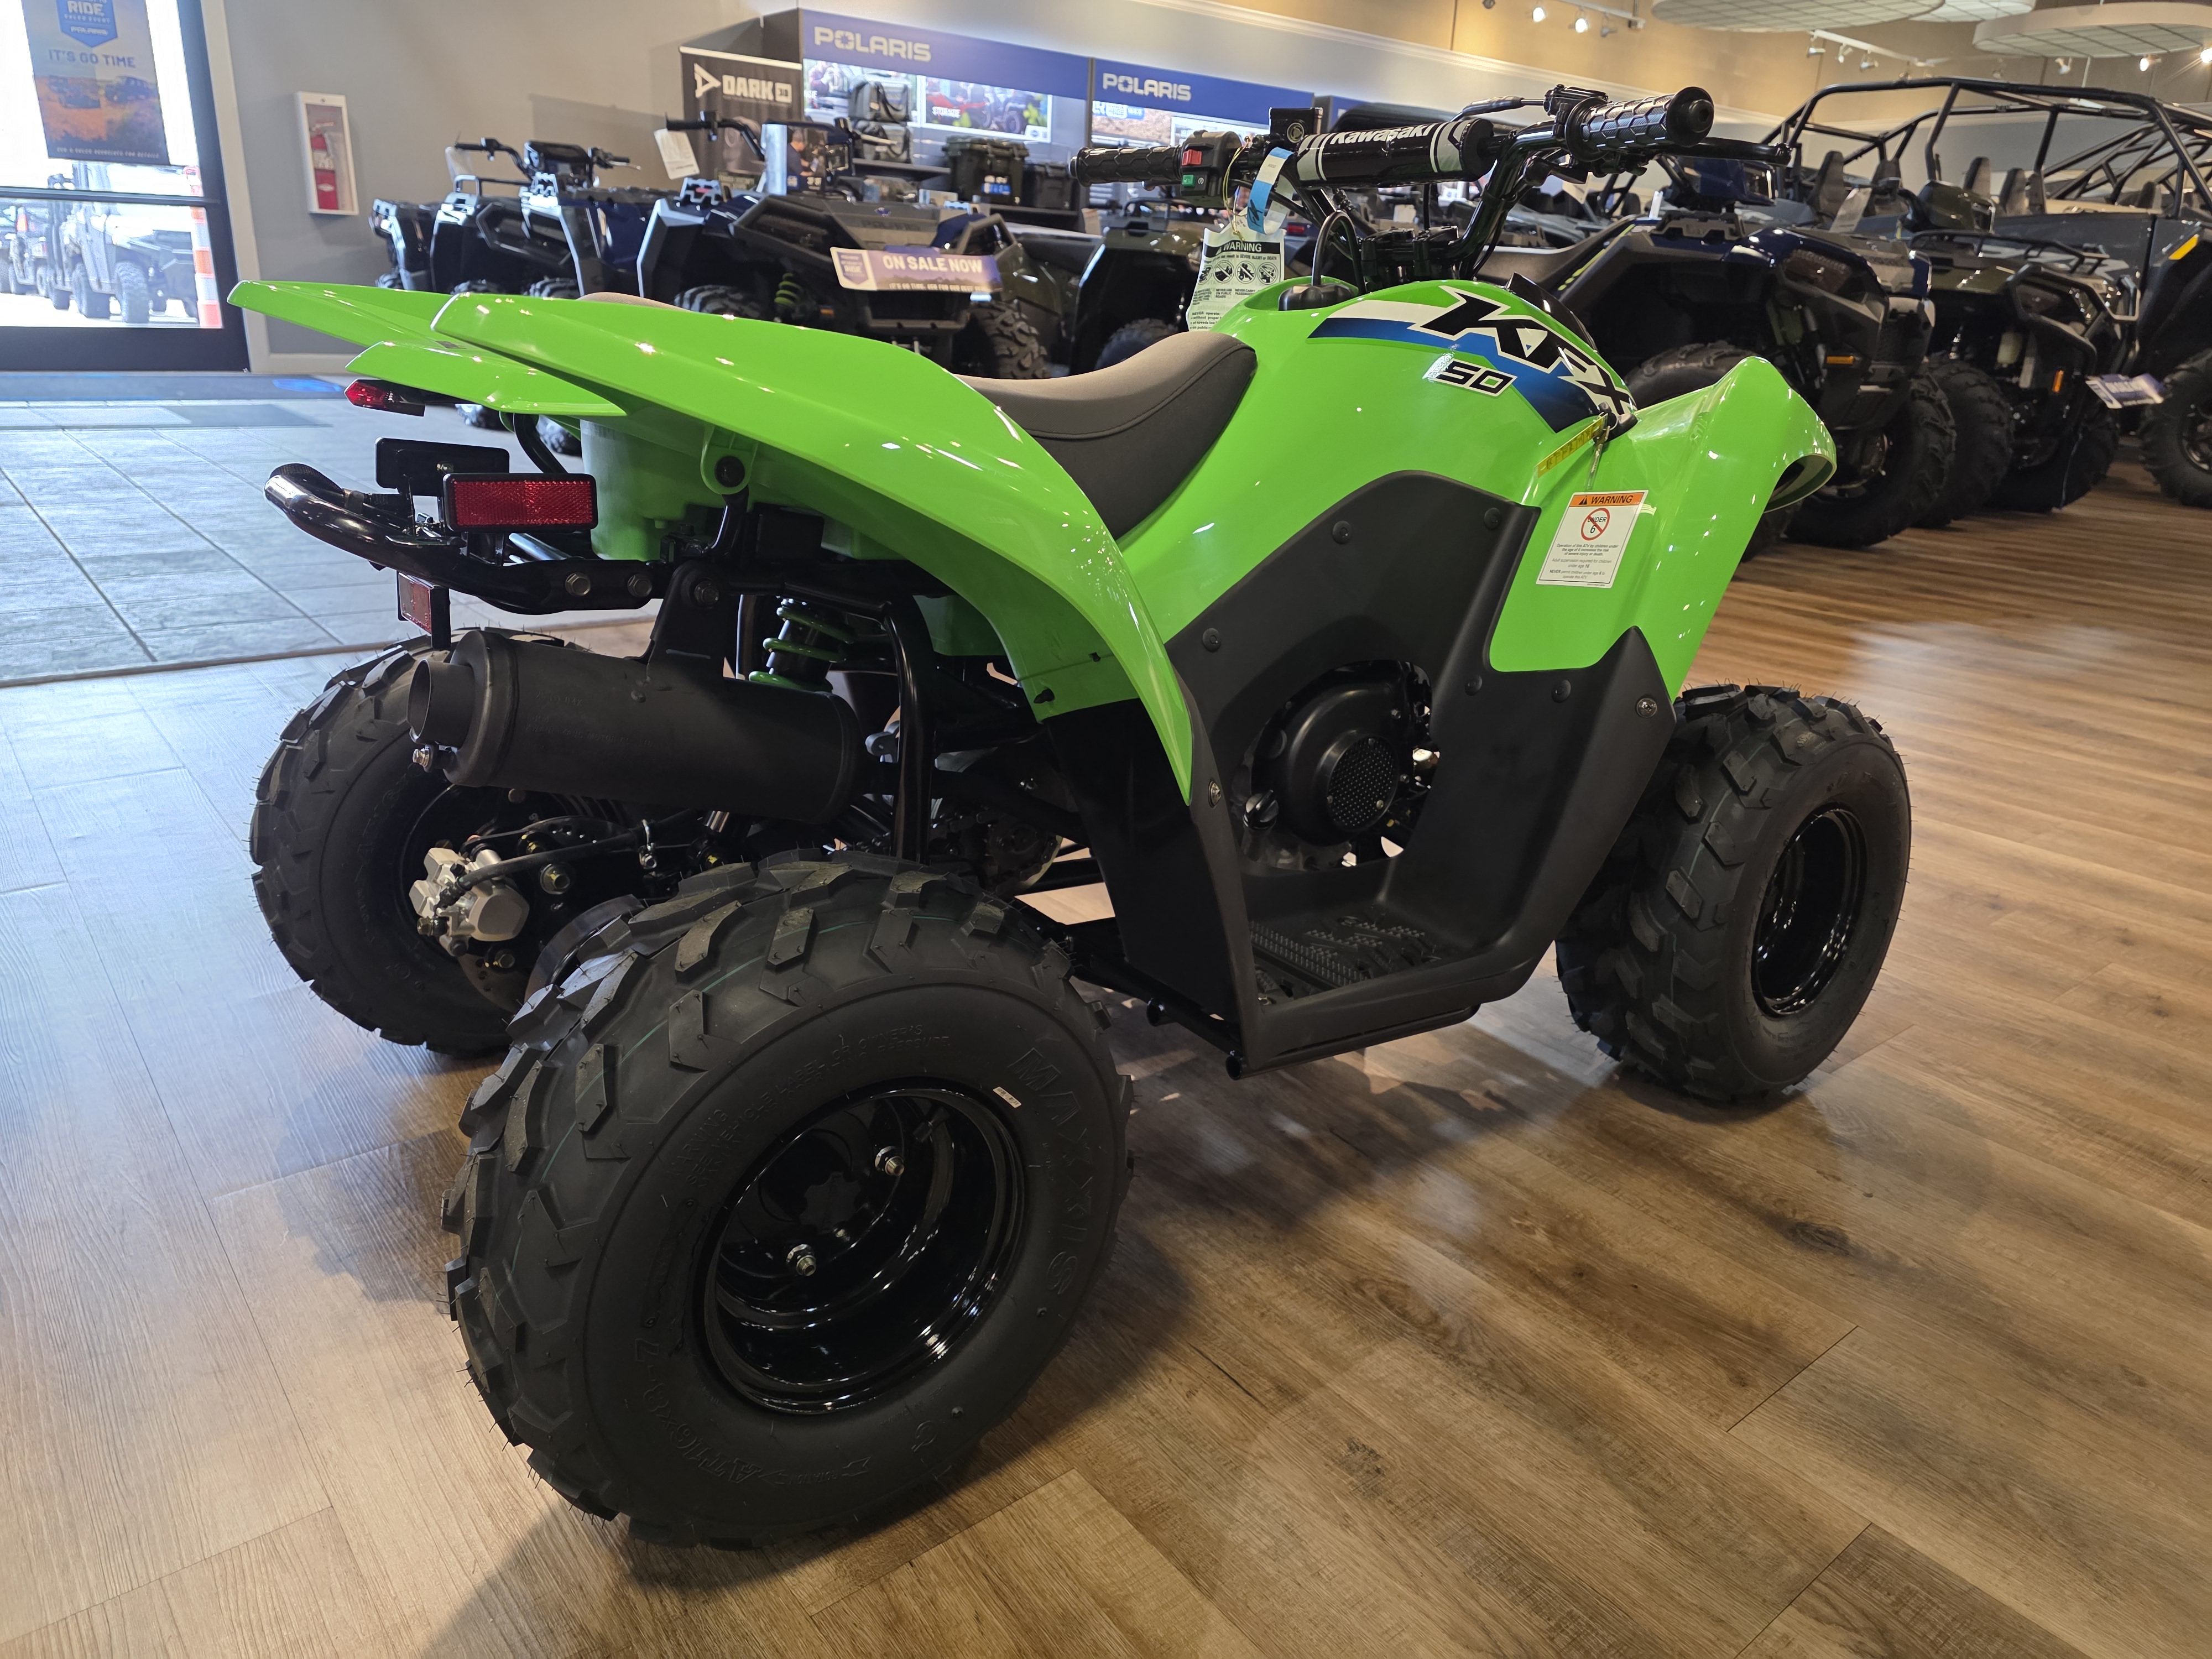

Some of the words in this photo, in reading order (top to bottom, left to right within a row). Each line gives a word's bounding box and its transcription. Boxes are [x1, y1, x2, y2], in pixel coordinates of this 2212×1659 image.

[67, 0, 105, 17] RIDE
[814, 27, 931, 62] POLARIS
[48, 49, 75, 62] IT'S
[80, 53, 99, 65] GO
[101, 54, 136, 69] TIME
[722, 75, 774, 101] DARK
[1103, 72, 1192, 102] POLARIS
[1329, 123, 1436, 144] Kawasaki
[1223, 242, 1262, 252] WARNING
[883, 255, 906, 270] ON
[907, 256, 947, 272] SALE
[948, 259, 983, 273] NOW
[1436, 359, 1512, 394] 50
[1591, 495, 1634, 504] WARNING
[1590, 525, 1597, 534] 6
[1006, 1047, 1094, 1296] MAXXIS
